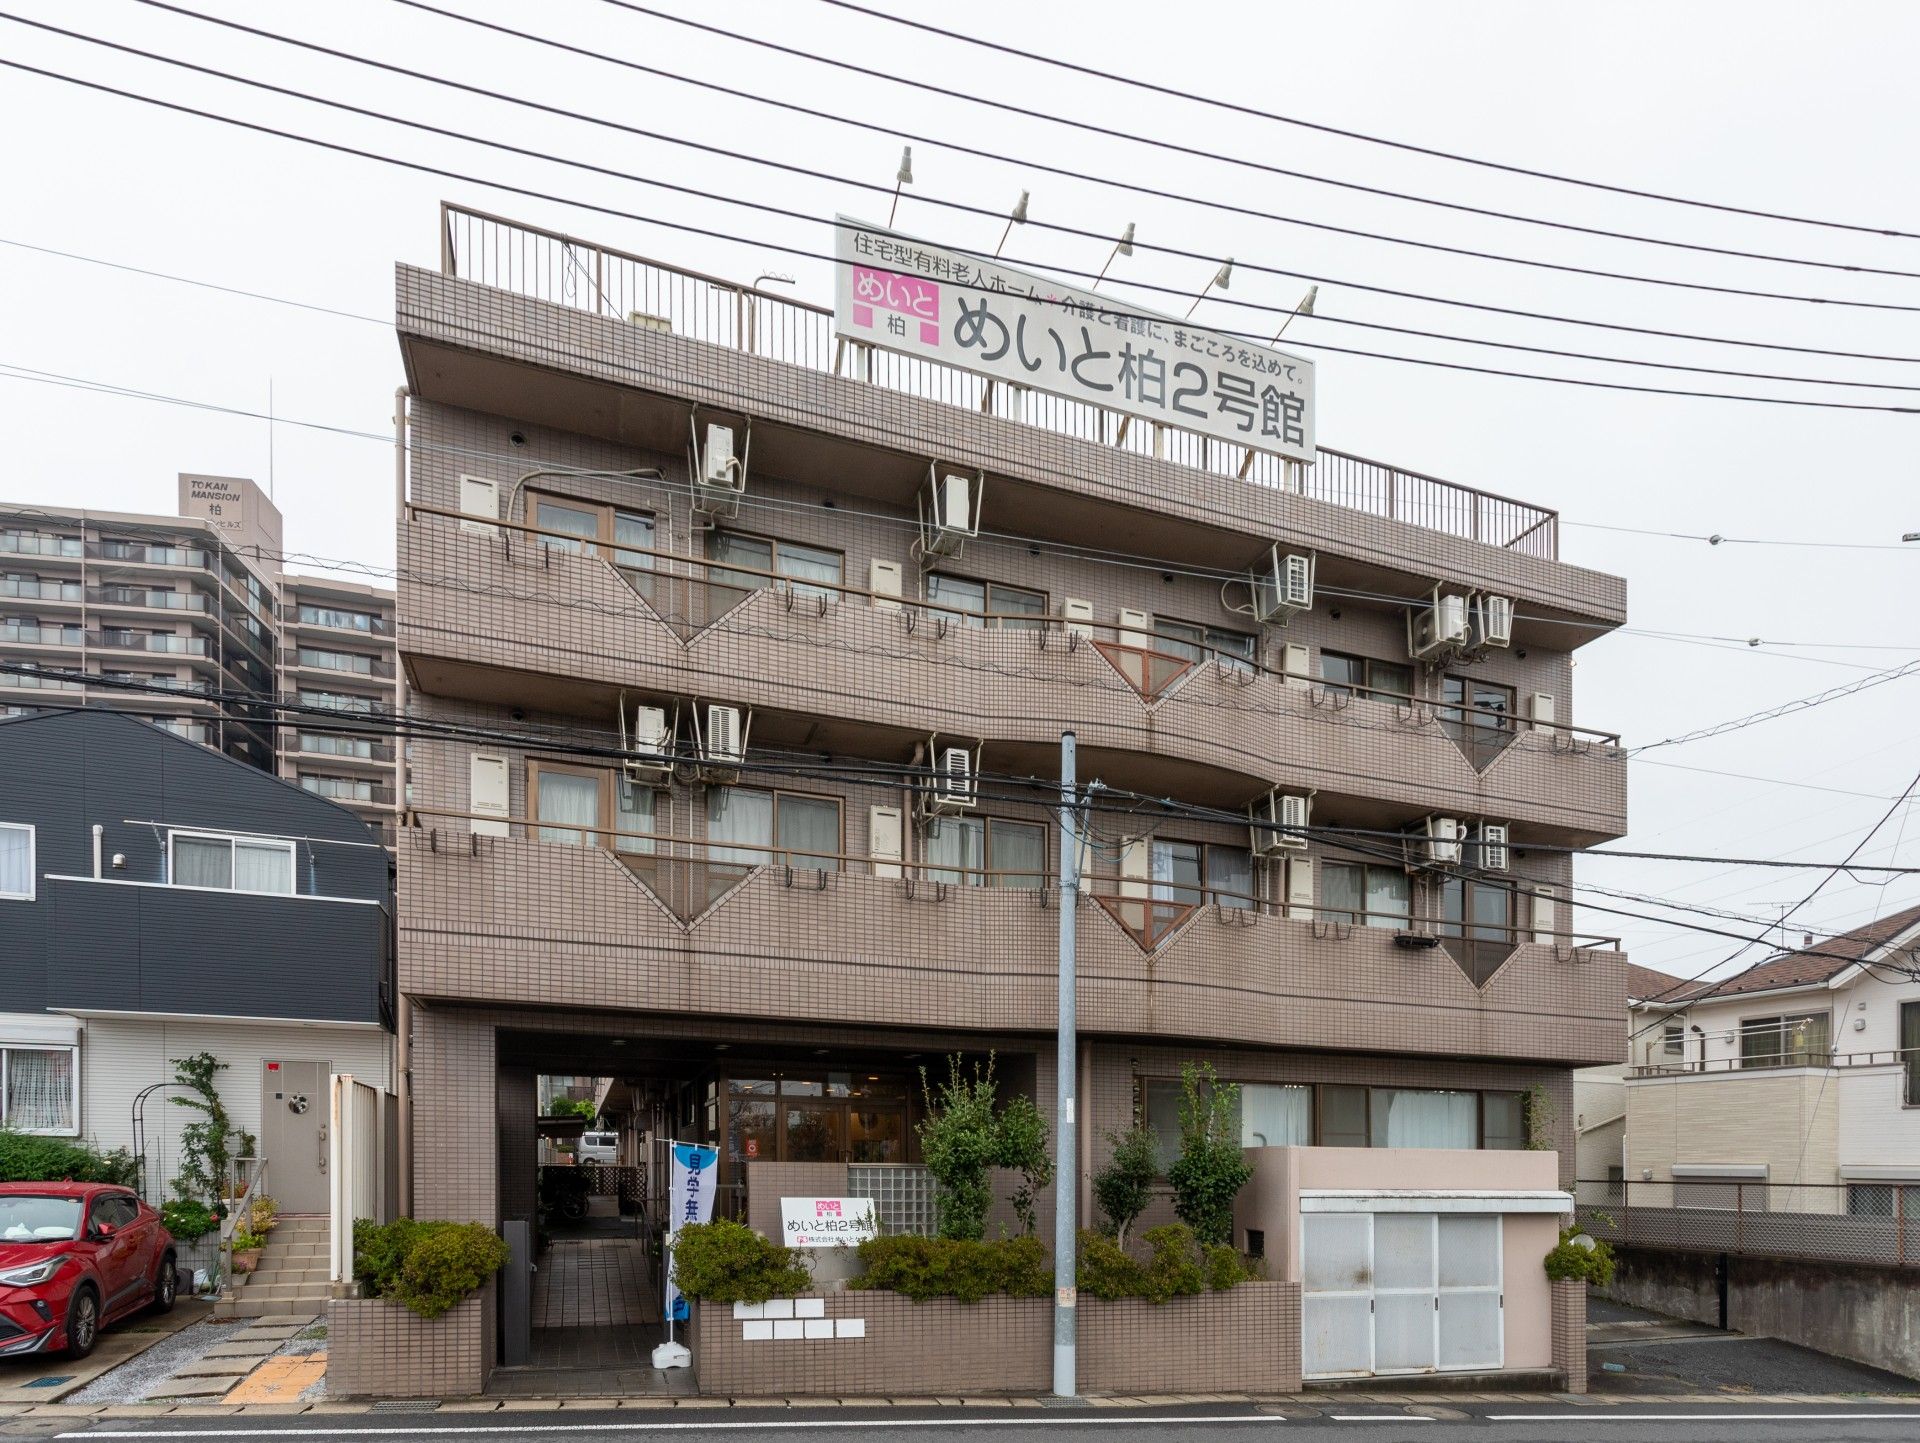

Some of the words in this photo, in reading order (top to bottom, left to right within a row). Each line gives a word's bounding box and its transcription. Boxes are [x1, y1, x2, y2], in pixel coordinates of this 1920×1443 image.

[854, 232, 1042, 306] 住宅型有料老人ホーム
[857, 271, 934, 317] めいと
[887, 313, 906, 337] 柏
[953, 296, 1305, 448] めいと柏2号館
[191, 490, 241, 502] MANSION
[209, 503, 222, 516] 柏
